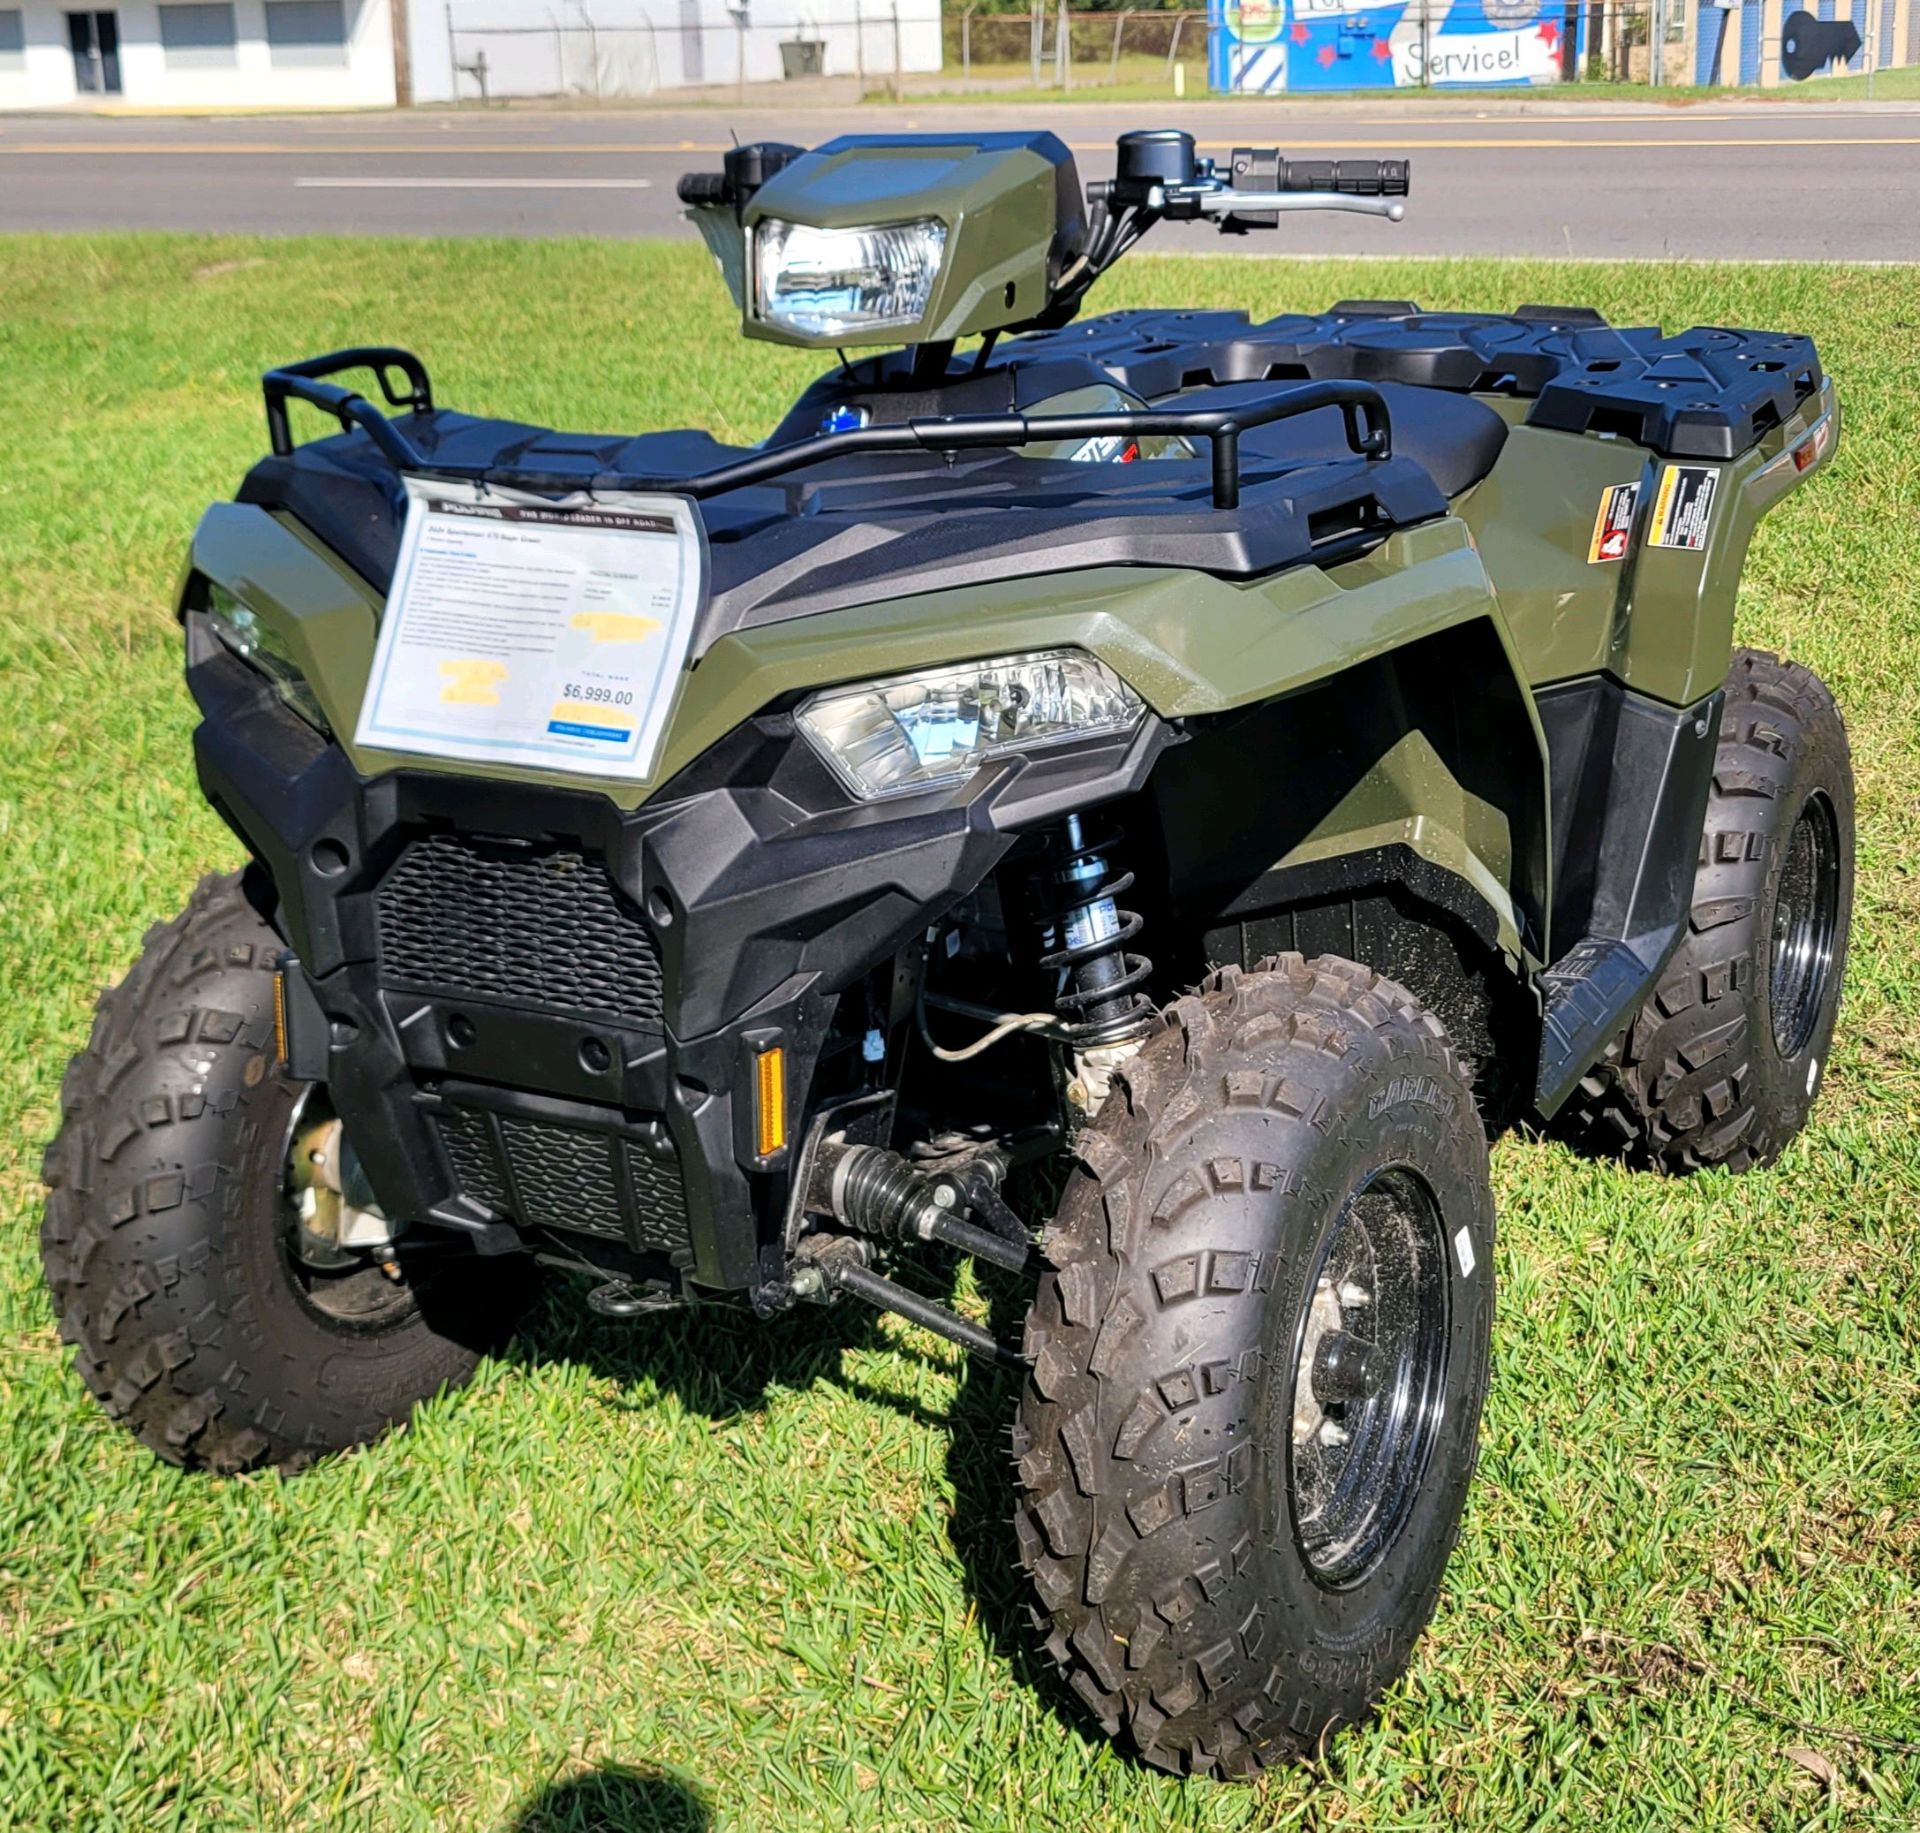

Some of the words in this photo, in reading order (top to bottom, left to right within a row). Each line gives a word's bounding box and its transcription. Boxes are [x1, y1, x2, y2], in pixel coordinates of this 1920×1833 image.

[1405, 35, 1519, 80] Service!
[571, 513, 602, 523] LEADER
[563, 683, 633, 705] $6,999.00
